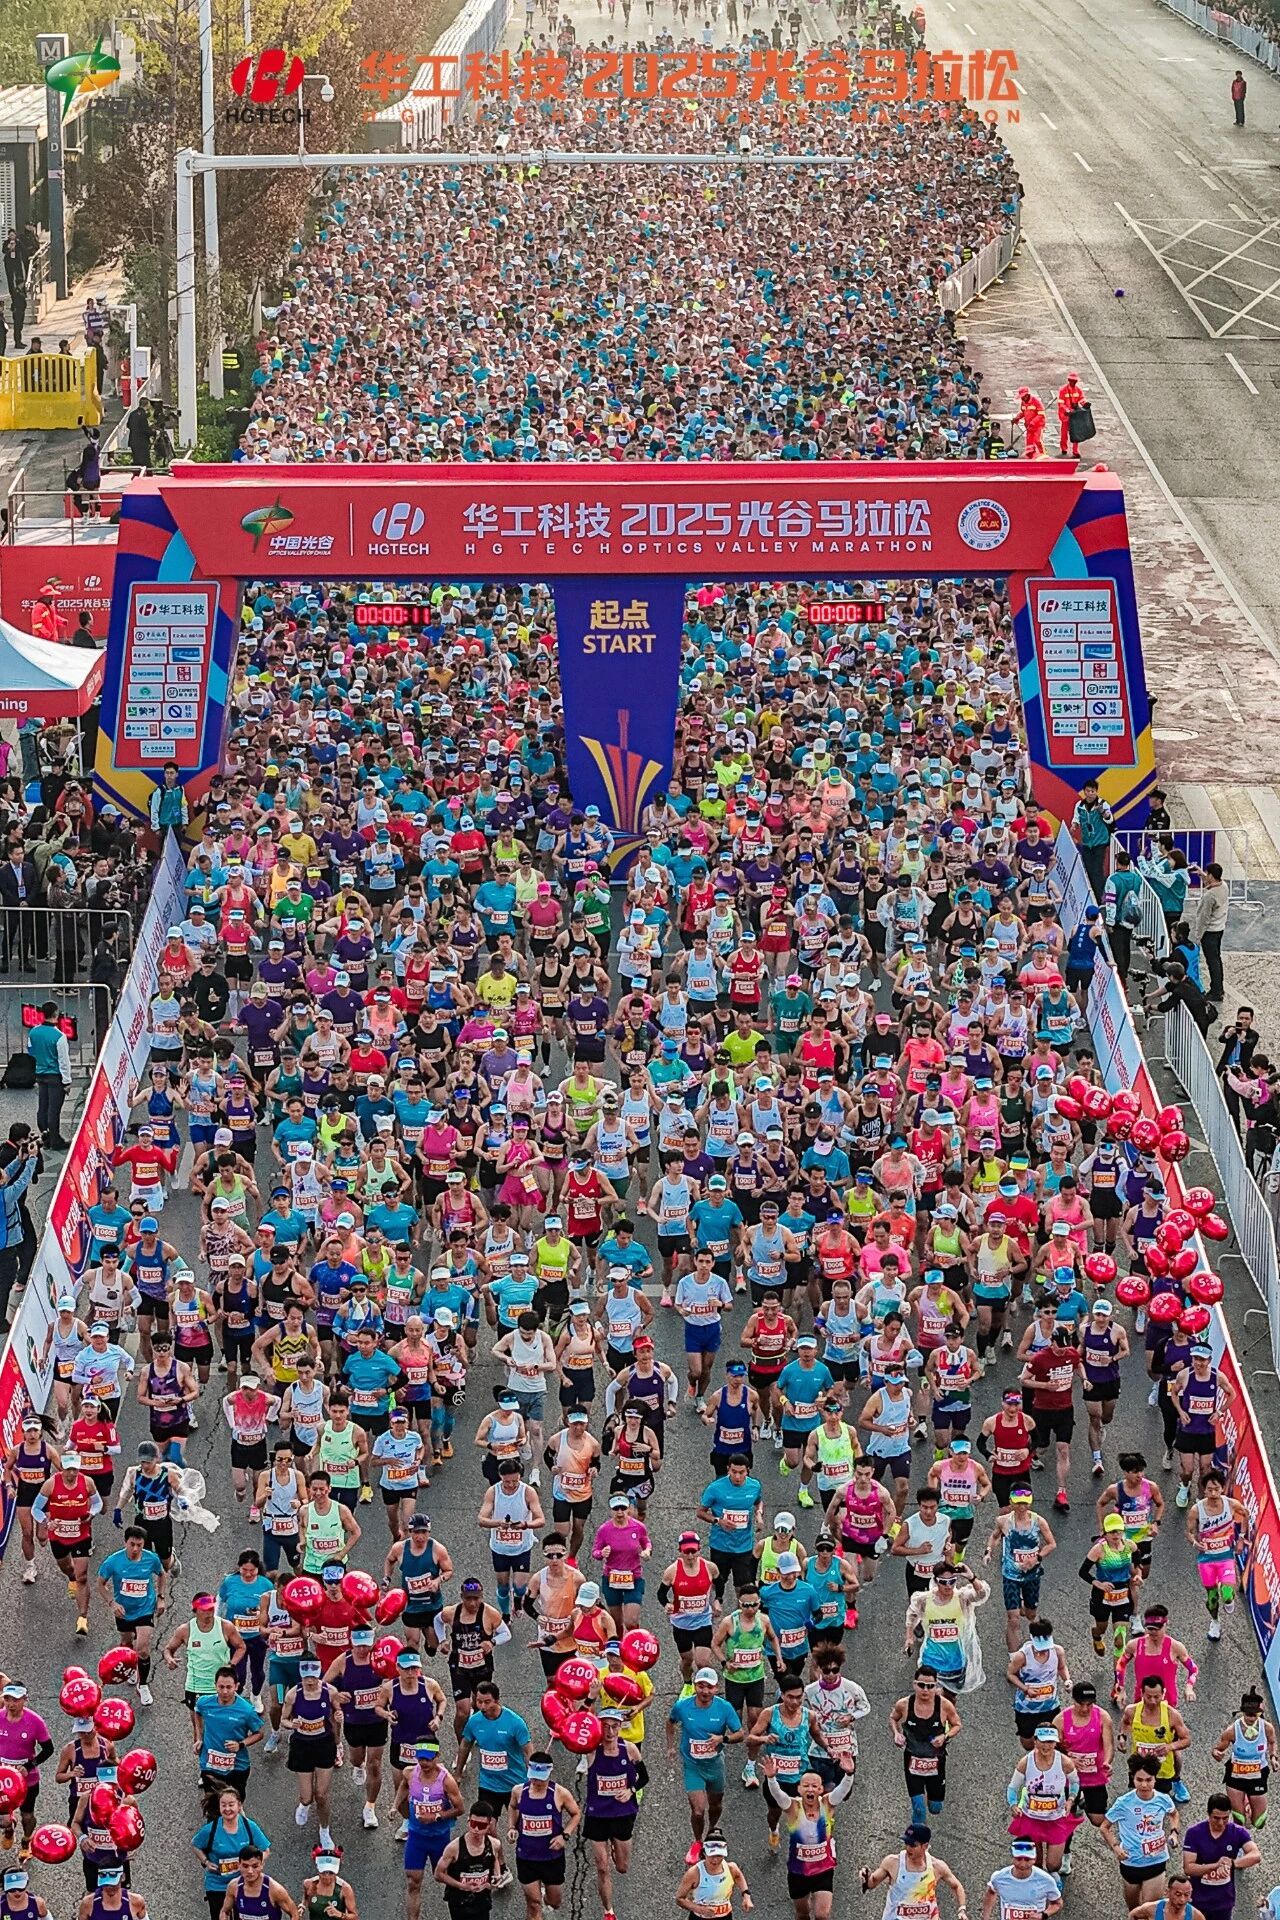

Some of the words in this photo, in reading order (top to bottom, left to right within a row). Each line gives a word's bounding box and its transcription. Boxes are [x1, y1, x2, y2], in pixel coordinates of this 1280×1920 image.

[462, 502, 611, 538] 华工科技
[269, 535, 335, 550] 中国光谷
[368, 543, 430, 556] HGTECH
[622, 542, 704, 554] OPTICS
[716, 542, 799, 554] VALLEY
[812, 542, 932, 553] MARATHON
[158, 604, 204, 615] 华工科技
[810, 605, 883, 622] 00:00:11
[1061, 600, 1108, 612] 华工科技
[356, 606, 430, 624] 00:00:11
[590, 600, 650, 630] 起点
[583, 634, 656, 654] START
[290, 1587, 318, 1598] 4:30
[632, 1640, 657, 1654] 4:00
[563, 1665, 593, 1679] 4:00
[101, 1706, 131, 1722] 3:45
[577, 1718, 590, 1745] 4:00
